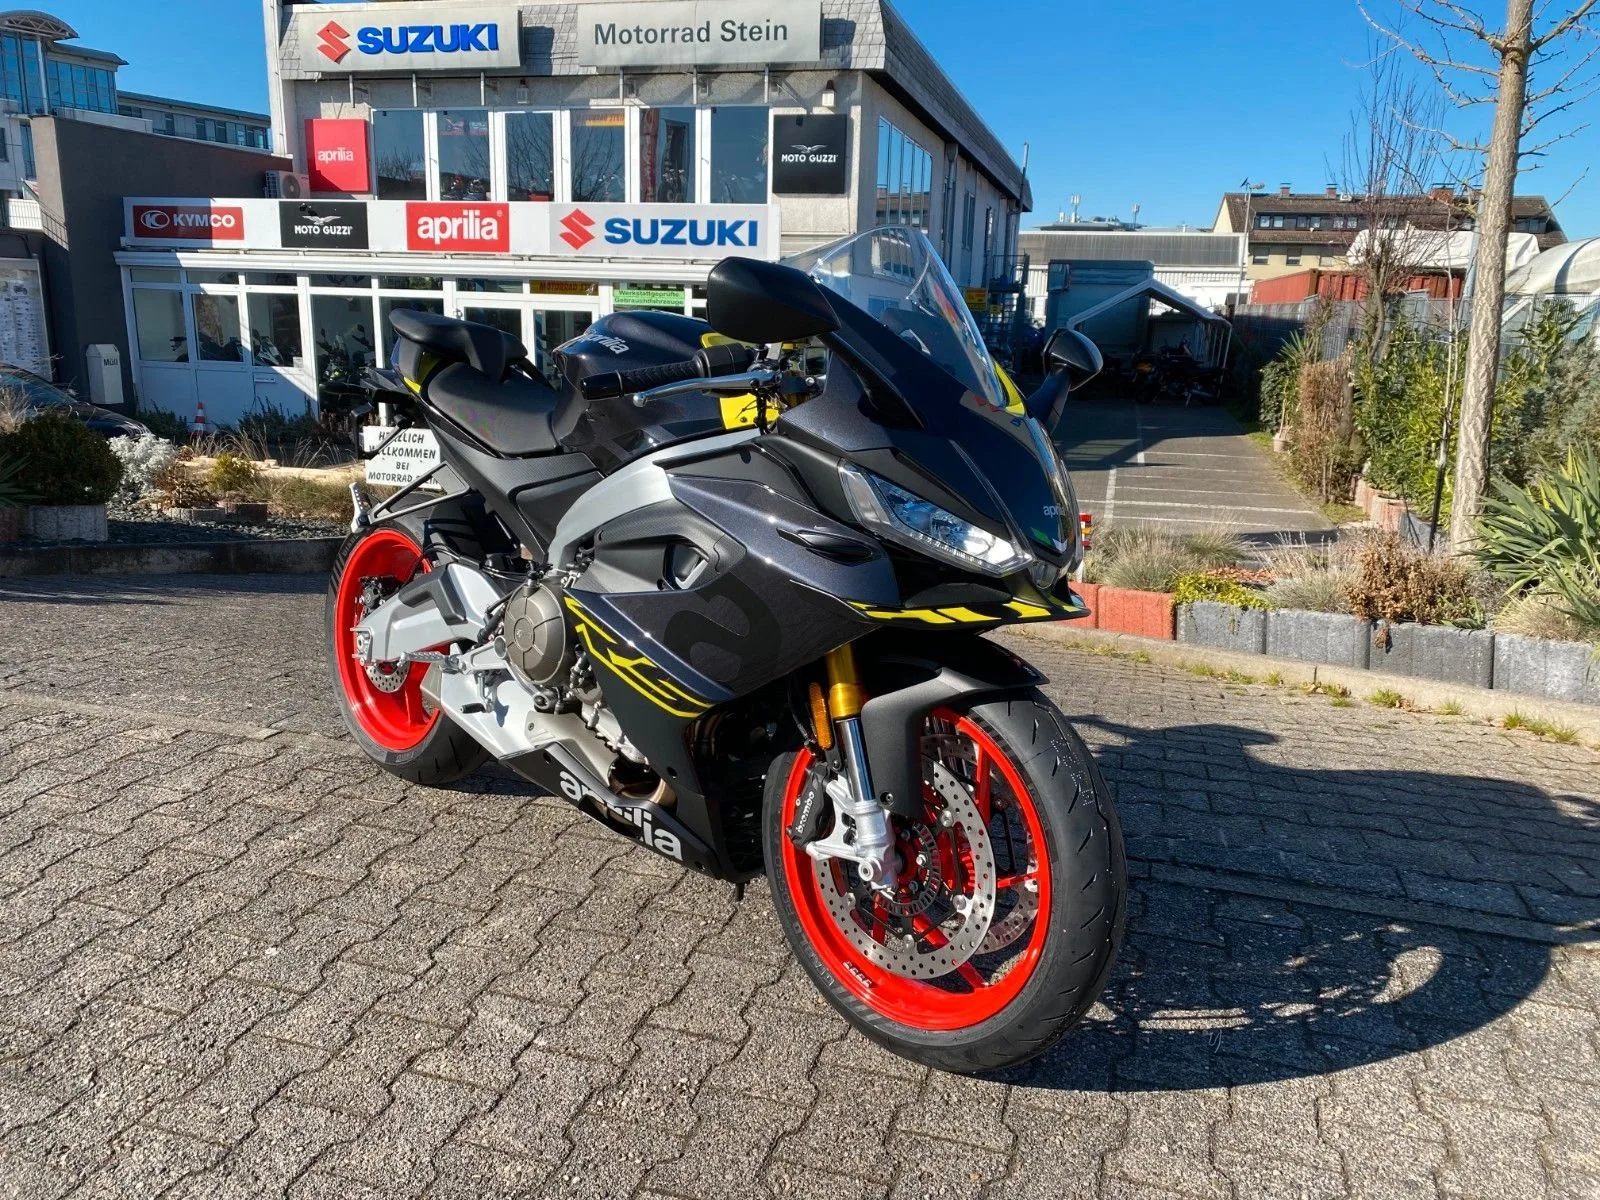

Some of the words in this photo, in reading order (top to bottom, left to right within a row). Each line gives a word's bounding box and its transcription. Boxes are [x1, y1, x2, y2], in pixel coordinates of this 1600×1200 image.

[357, 23, 499, 55] SUZUKI
[594, 20, 710, 45] Motorrad
[720, 18, 788, 42] Stein
[318, 147, 354, 164] aprilia
[781, 153, 806, 162] MOTO
[809, 153, 837, 163] GUZZI
[173, 213, 235, 228] KYMCO
[417, 209, 498, 245] aprilia
[294, 225, 320, 234] MOTO
[322, 225, 351, 235] GUZZI
[604, 217, 758, 247] SUZUKI
[379, 431, 425, 444] HZLICH
[369, 445, 436, 459] LLKOMMEN
[396, 461, 410, 470] BEI
[368, 471, 413, 483] MOTORRAD
[796, 791, 815, 834] brembo
